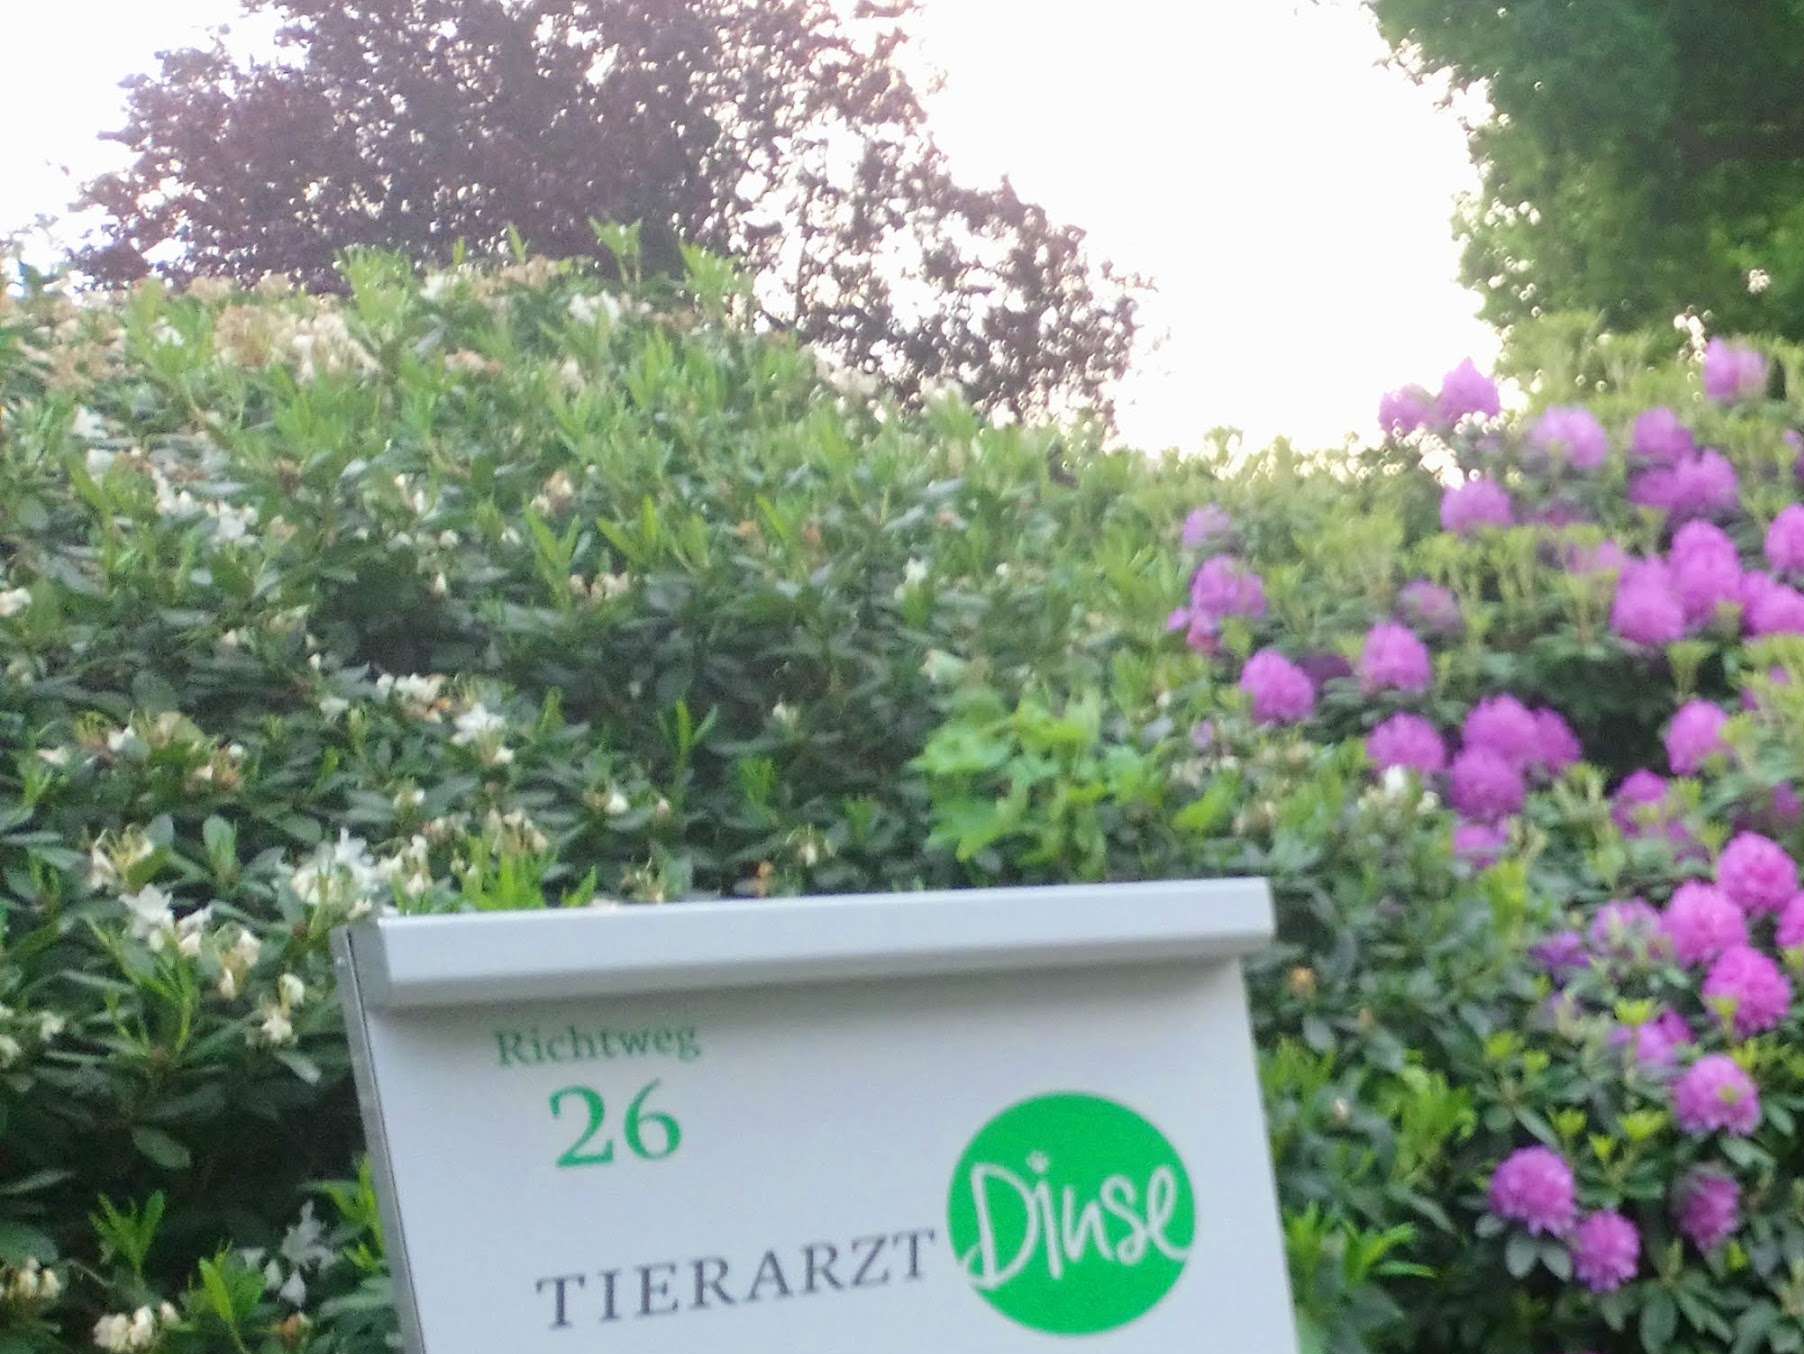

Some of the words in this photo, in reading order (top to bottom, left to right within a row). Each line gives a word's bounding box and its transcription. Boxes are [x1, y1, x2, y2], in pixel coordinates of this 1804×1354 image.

[498, 1021, 701, 1067] Richtweg
[549, 1079, 682, 1168] 26
[535, 1228, 935, 1329] TIERARZT
[960, 1150, 1195, 1291] Dinse
